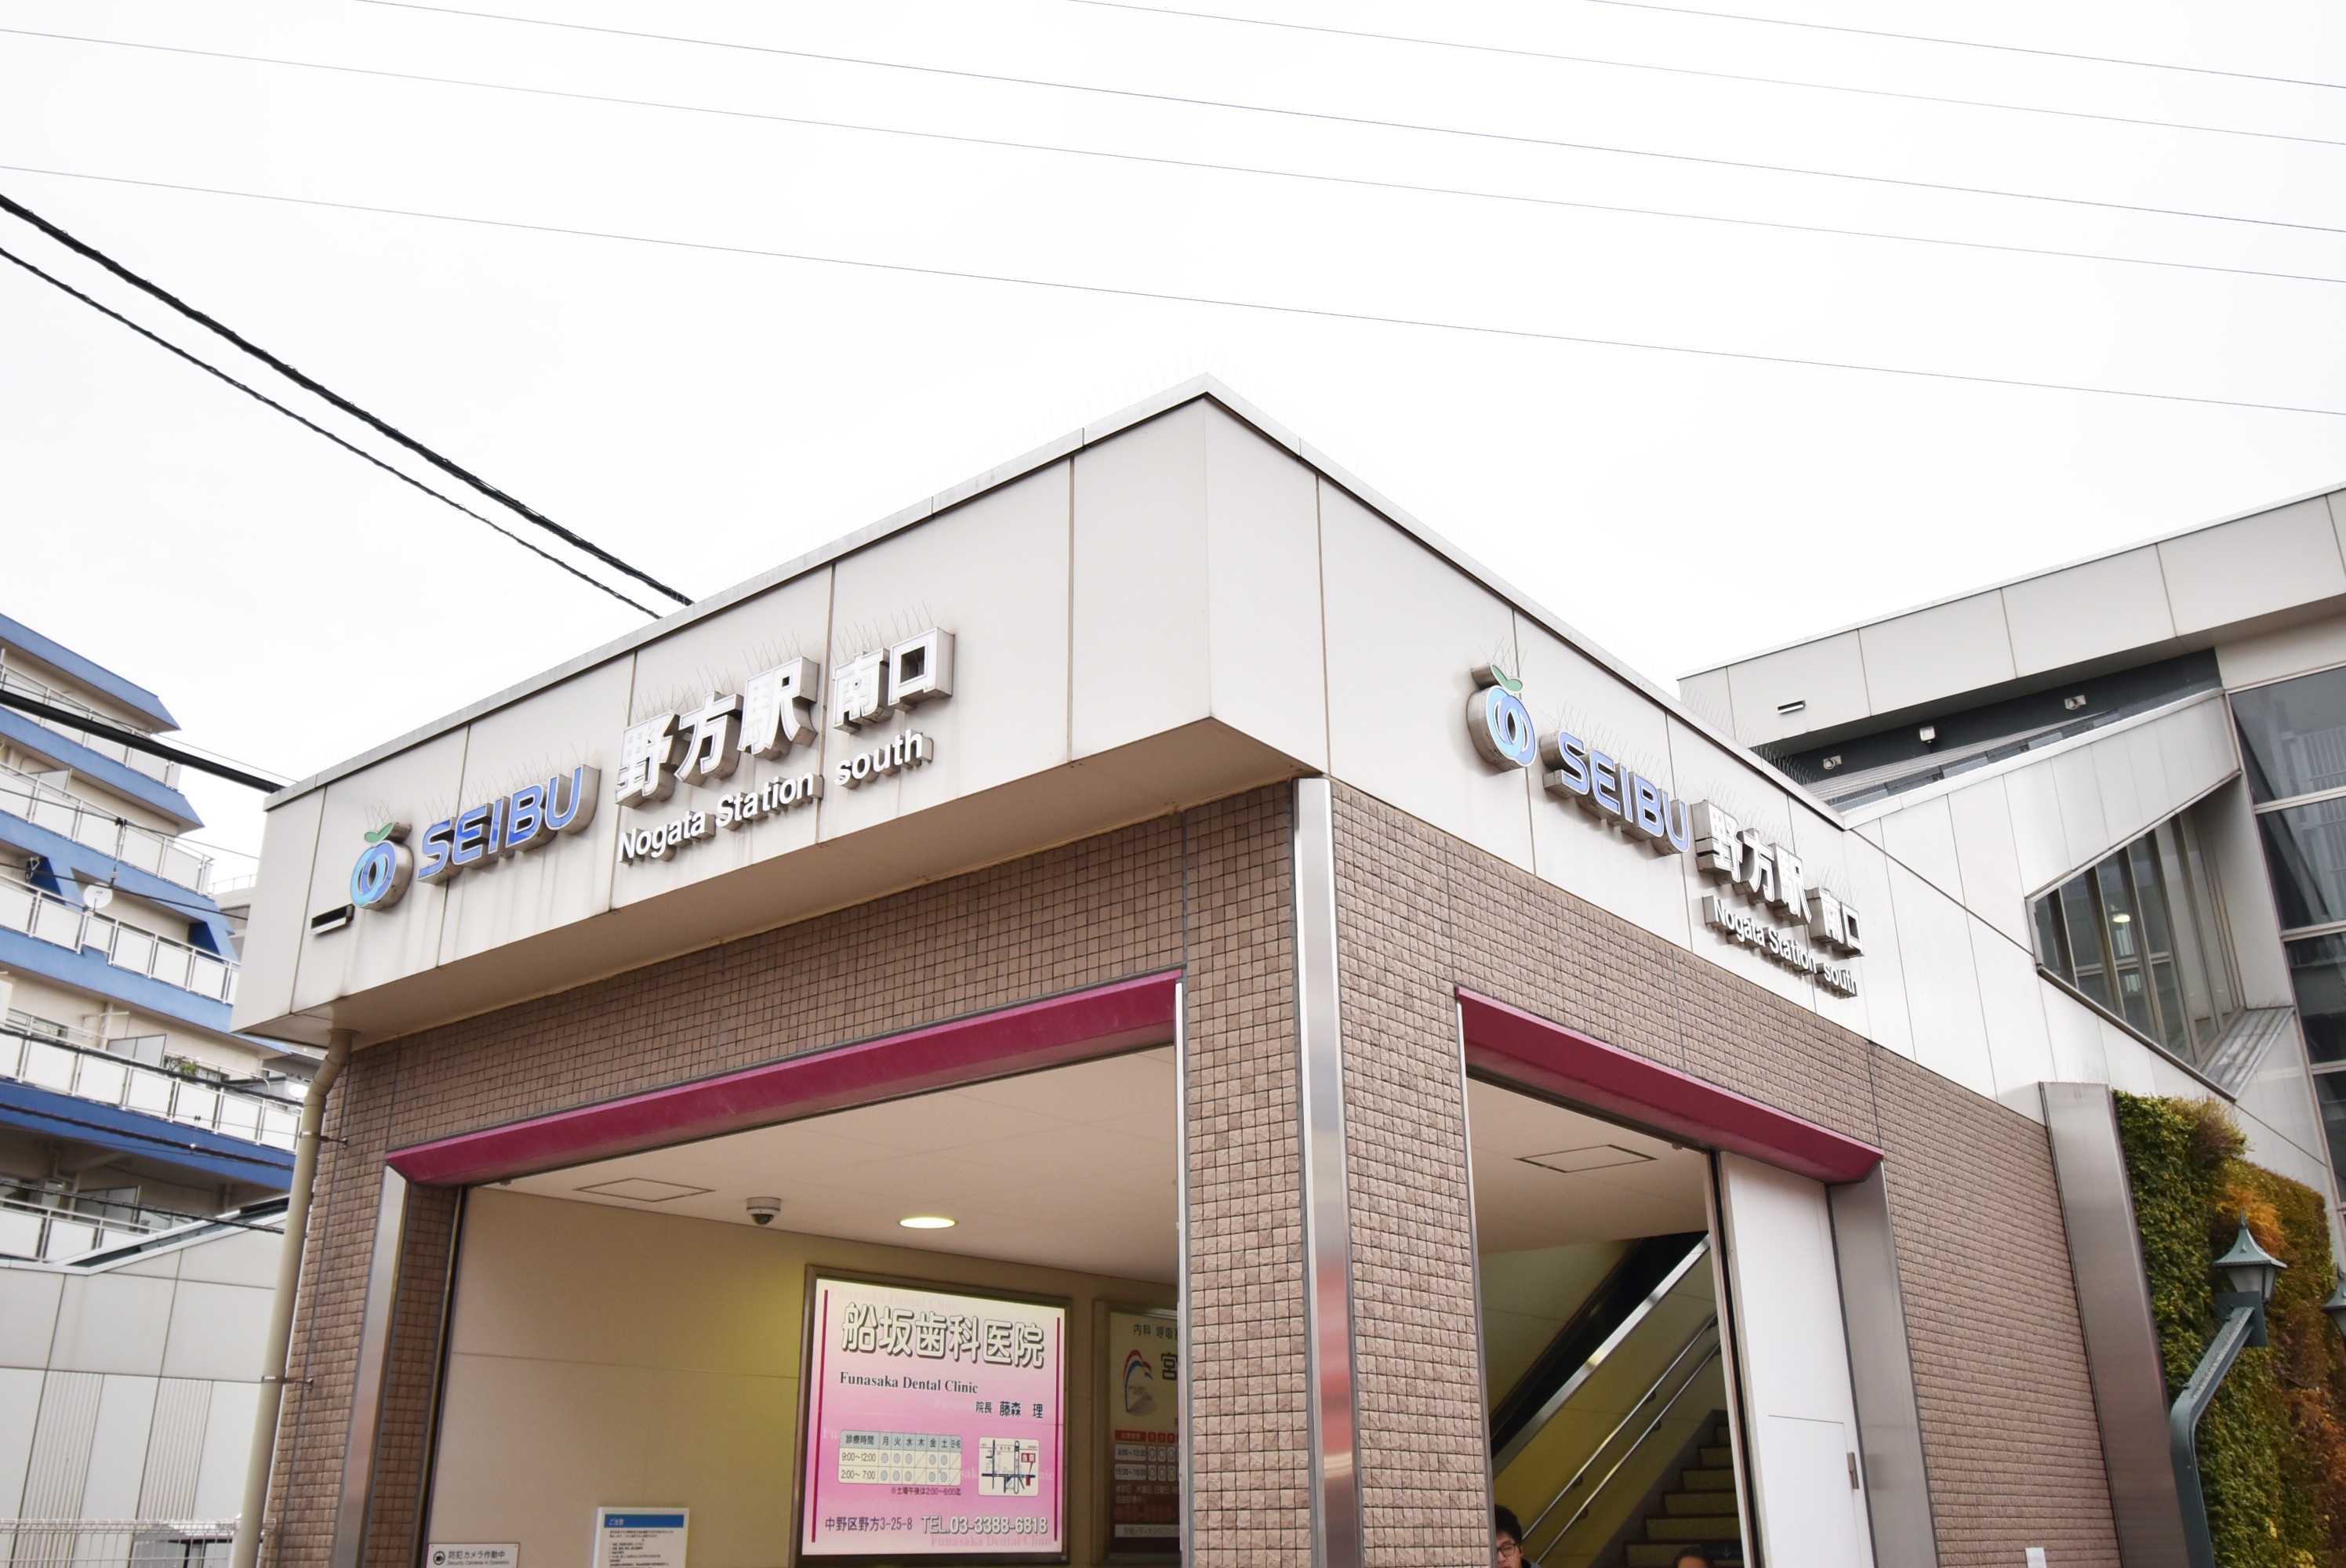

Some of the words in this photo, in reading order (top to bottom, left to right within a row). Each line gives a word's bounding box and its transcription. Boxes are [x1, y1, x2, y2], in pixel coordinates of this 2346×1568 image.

[616, 656, 818, 807] 野方駅
[833, 627, 953, 731] 南口
[418, 764, 597, 885] SEIBU
[618, 811, 711, 864] Nogata
[715, 771, 821, 829] Station
[834, 730, 932, 788] south
[1546, 730, 1690, 855] SEIBU
[1700, 800, 1812, 924] 野方駅
[1814, 887, 1864, 956] 南口
[1709, 896, 1766, 947] Nogata
[1767, 928, 1818, 975] Station
[1819, 963, 1858, 996] south
[841, 1301, 1044, 1369] 船坂歯科医院
[840, 1371, 899, 1388] Funasaka
[902, 1376, 941, 1392] Dental
[944, 1380, 979, 1394] Clinic
[975, 1400, 993, 1414] 院長
[999, 1400, 1022, 1417] 藤森
[1032, 1403, 1044, 1418] 理
[845, 1434, 874, 1446] 診療時間
[882, 1436, 889, 1446] 月
[894, 1437, 901, 1446] 火
[906, 1438, 913, 1447] 水
[917, 1438, 925, 1447] 木
[929, 1438, 936, 1448] 金
[941, 1439, 948, 1448] 土
[825, 1515, 913, 1533] 中野区野方3-25-8
[921, 1515, 1048, 1534] TEL.03-3388-6818
[931, 1535, 981, 1547] Funasaka
[983, 1535, 1019, 1547] Dental
[1022, 1534, 1053, 1547] Clinic
